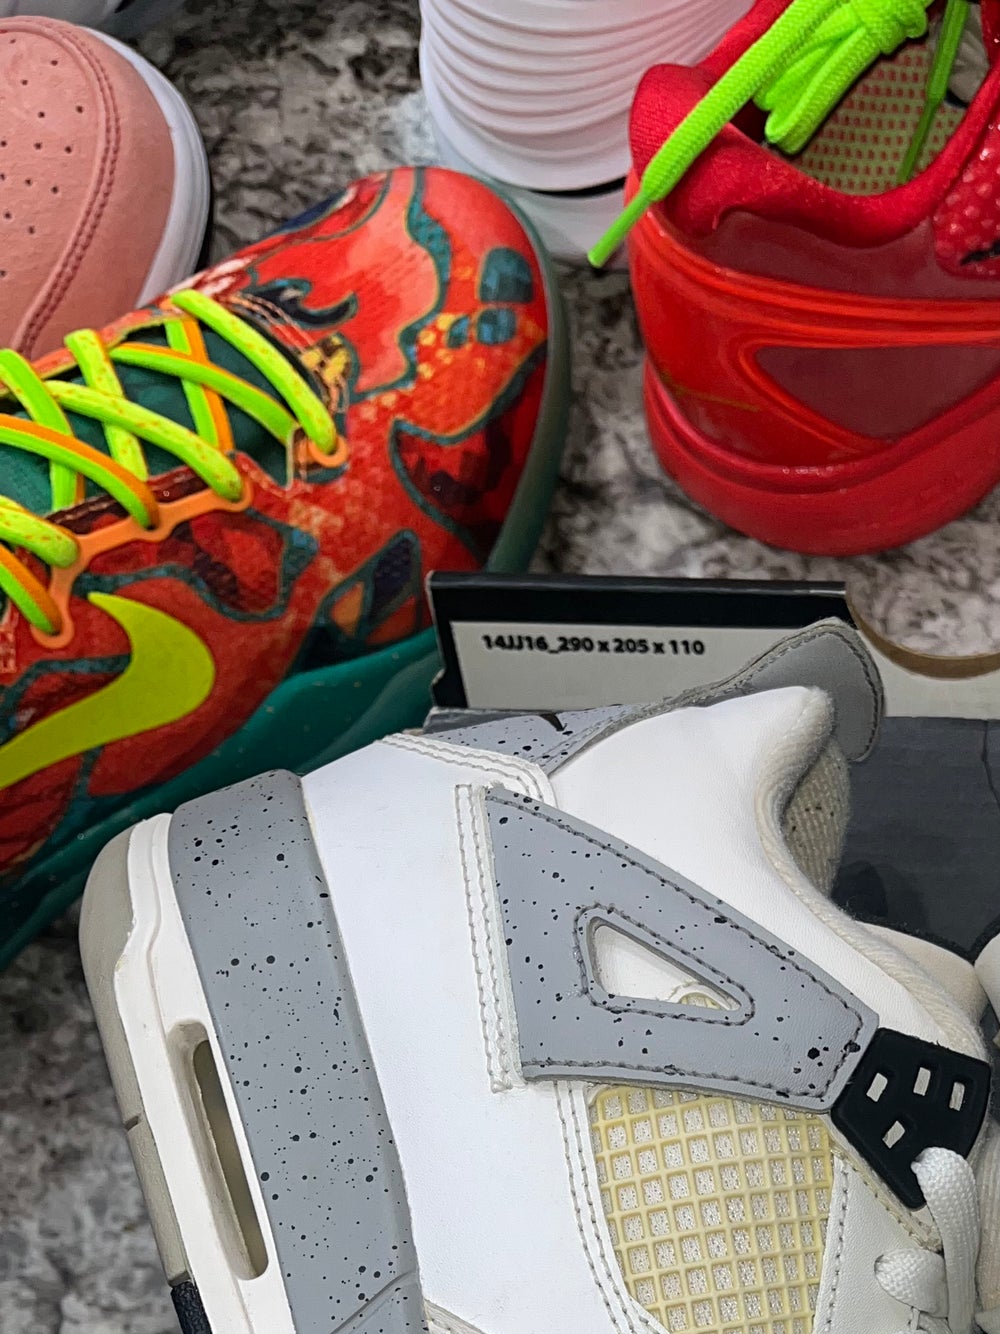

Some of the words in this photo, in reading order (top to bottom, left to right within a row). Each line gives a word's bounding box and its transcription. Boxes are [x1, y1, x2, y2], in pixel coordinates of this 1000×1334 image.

[598, 640, 611, 653] x
[613, 638, 650, 653] 205
[653, 642, 665, 654] x
[669, 640, 705, 655] 110
